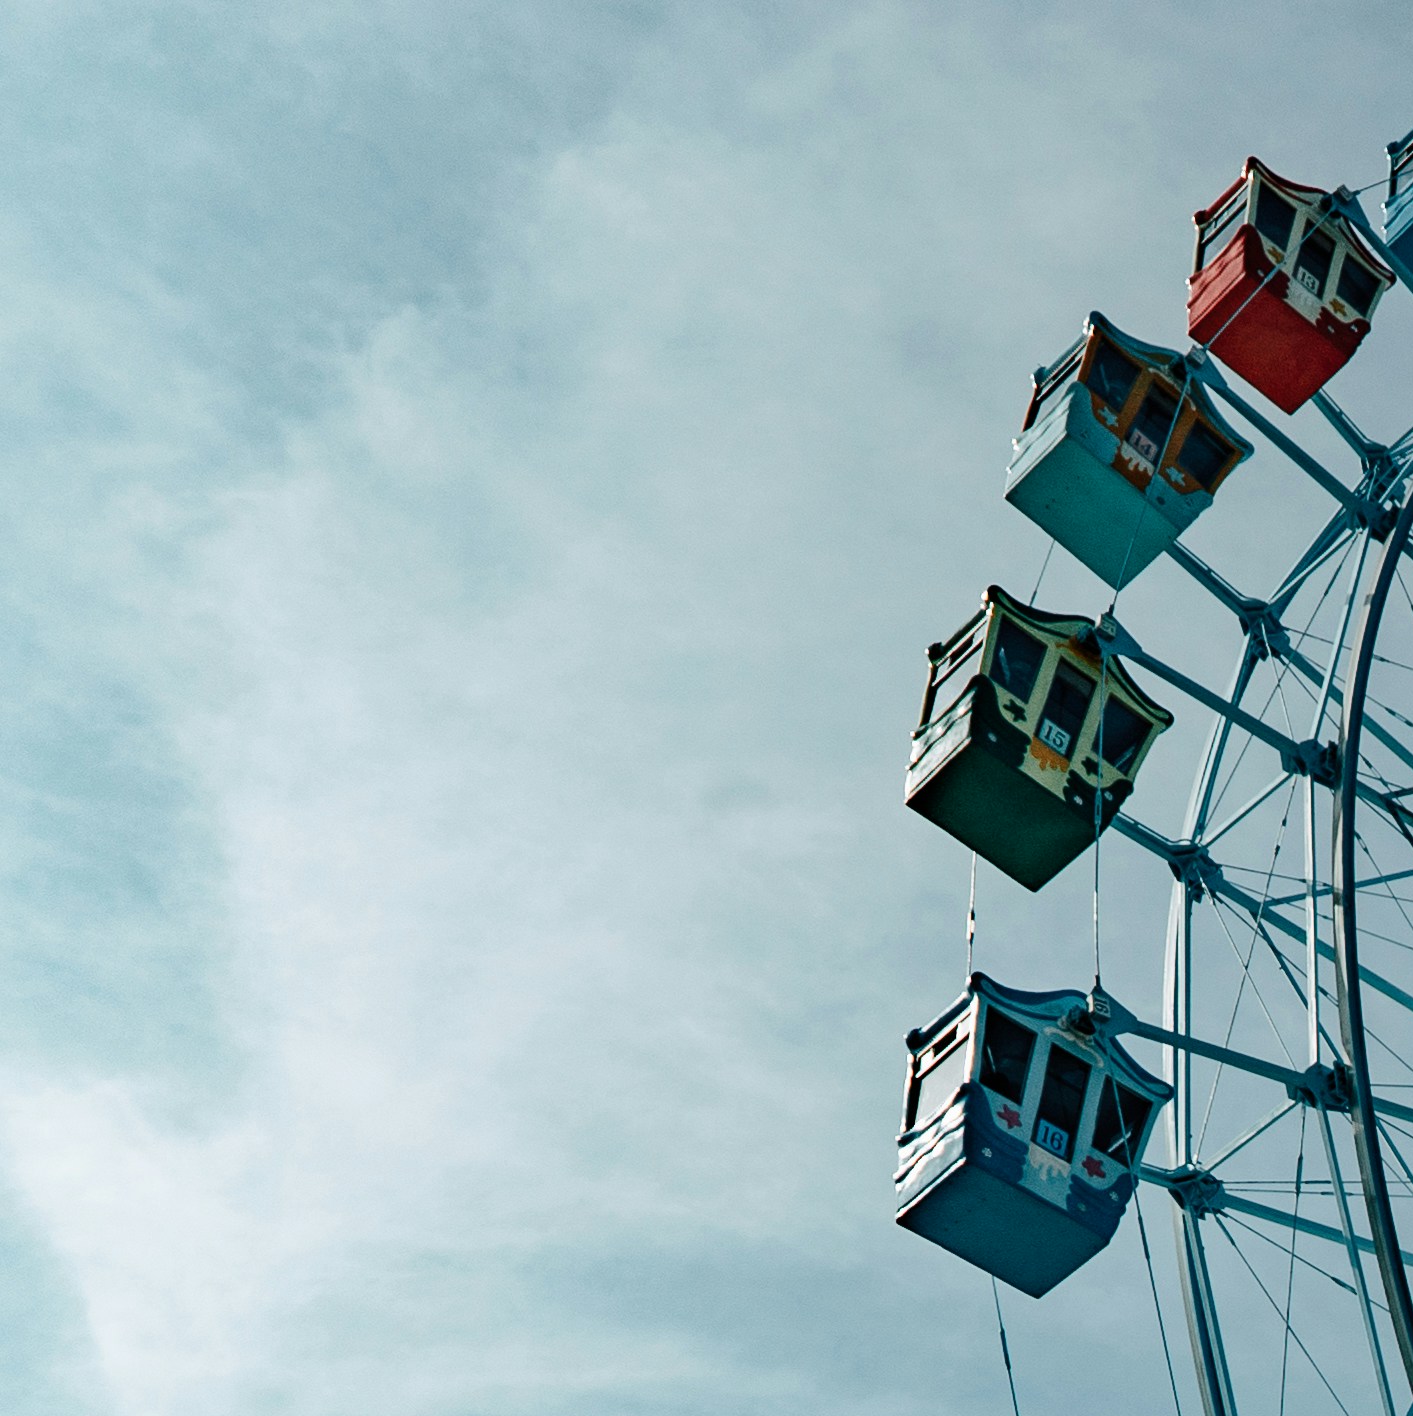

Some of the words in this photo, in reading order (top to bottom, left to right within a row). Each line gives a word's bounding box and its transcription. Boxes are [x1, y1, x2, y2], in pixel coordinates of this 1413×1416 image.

[1301, 272, 1315, 291] 13
[1133, 435, 1152, 454] 14
[1044, 725, 1066, 748] 15
[1095, 998, 1108, 1013] 16
[1041, 1125, 1063, 1151] 16
